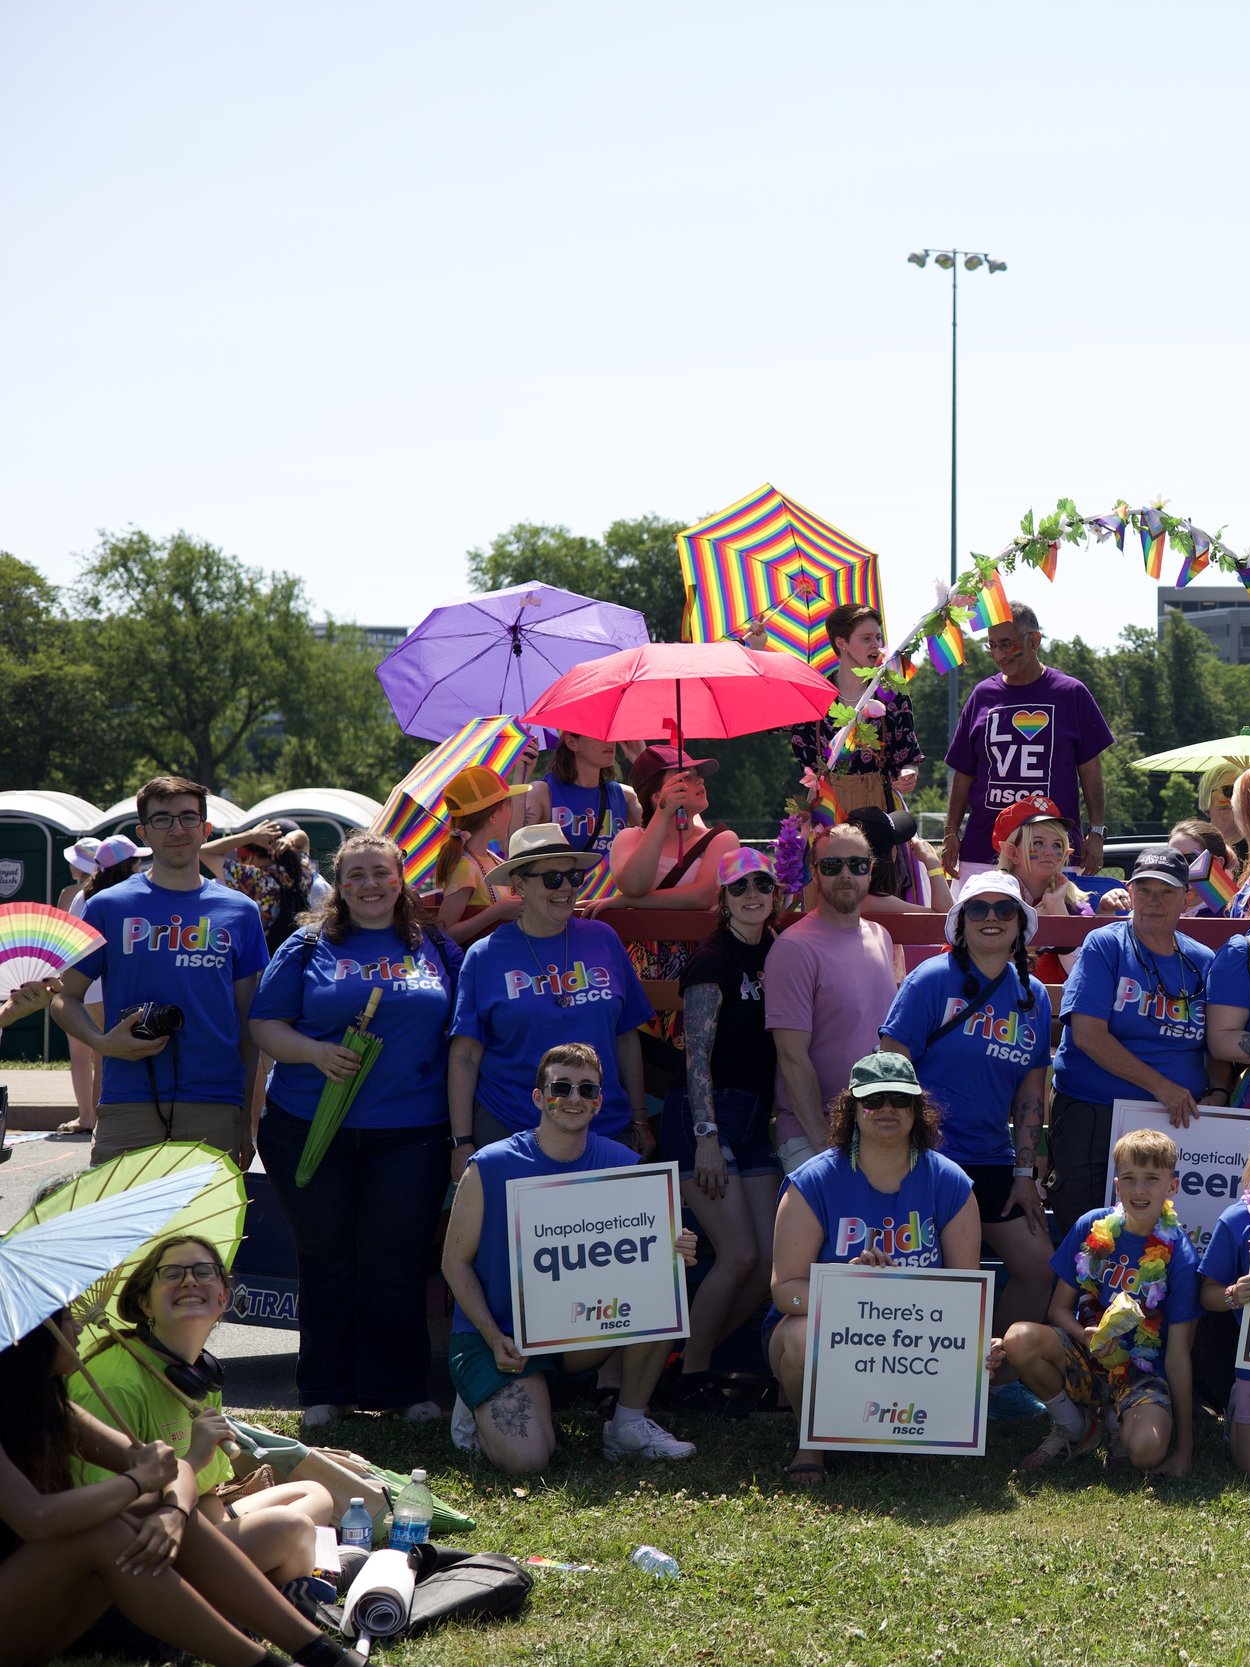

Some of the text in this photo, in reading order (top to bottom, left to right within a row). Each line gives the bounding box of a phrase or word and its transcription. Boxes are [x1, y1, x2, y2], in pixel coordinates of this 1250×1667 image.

[122, 915, 231, 955] Pride
[175, 954, 225, 968] nscc
[334, 955, 442, 981] Pride
[393, 980, 442, 991] nscc
[504, 961, 610, 1000] Pride
[1113, 976, 1206, 1026] Pride
[1159, 1023, 1205, 1041] nscc
[986, 1043, 1031, 1066] nscc
[1178, 1171, 1243, 1199] eer
[534, 1212, 656, 1238] Unapologetically
[835, 1211, 936, 1257] Pride
[533, 1235, 657, 1281] queer
[570, 1298, 631, 1323] Pride
[930, 1309, 943, 1323] a
[600, 1319, 631, 1330] nscc
[830, 1327, 966, 1353] place for you
[854, 1356, 939, 1376] at NSCC
[862, 1402, 927, 1425] Pride
[892, 1426, 925, 1436] nscc
